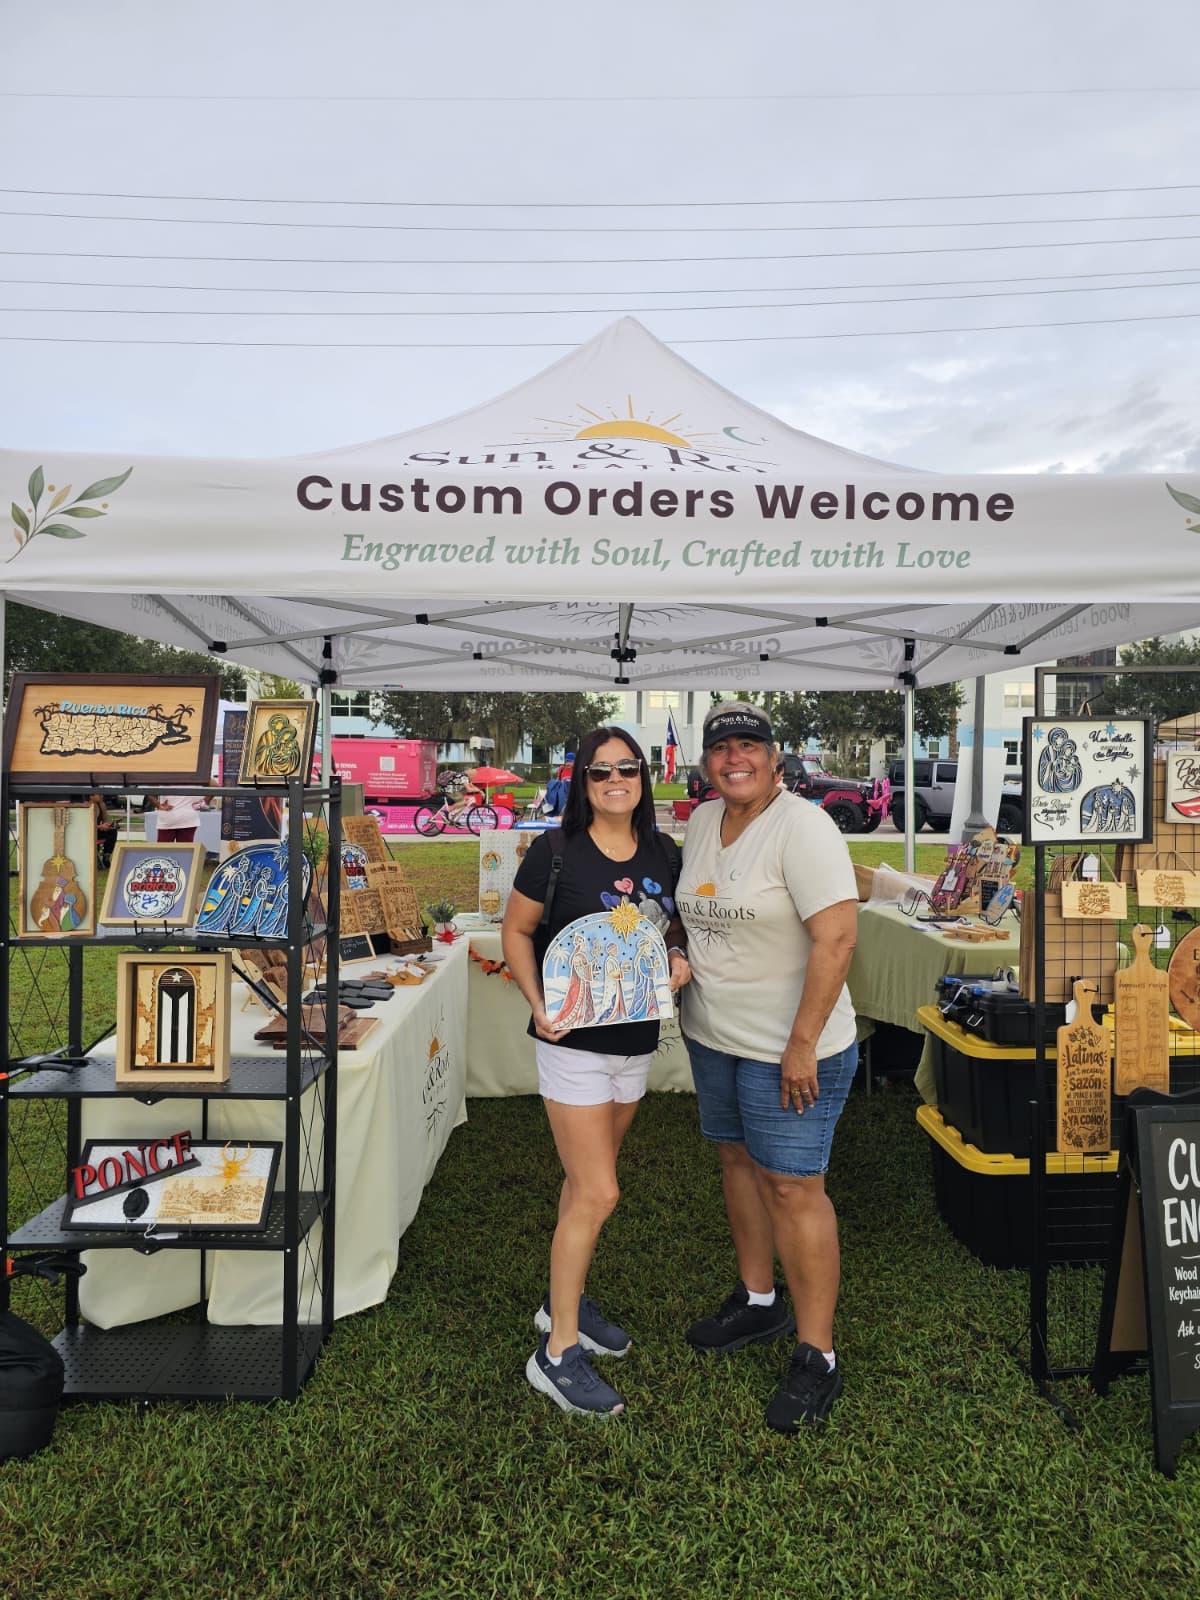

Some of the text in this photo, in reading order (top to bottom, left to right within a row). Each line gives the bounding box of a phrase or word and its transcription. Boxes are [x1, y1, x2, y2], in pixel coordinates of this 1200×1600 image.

[408, 450, 554, 466] Sun
[578, 442, 645, 461] &
[297, 475, 1014, 522] Custom Orders Welcome
[341, 533, 971, 577] Engraved with Soul, Crafted with Love
[60, 700, 149, 716] Puerto Rico
[693, 900, 704, 916] &
[709, 900, 755, 920] Roots
[1066, 1044, 1104, 1068] Latinas
[71, 1130, 197, 1201] PONCE
[1163, 1197, 1200, 1247] EN
[1174, 1265, 1198, 1281] Wood
[1177, 1319, 1195, 1338] Ask
